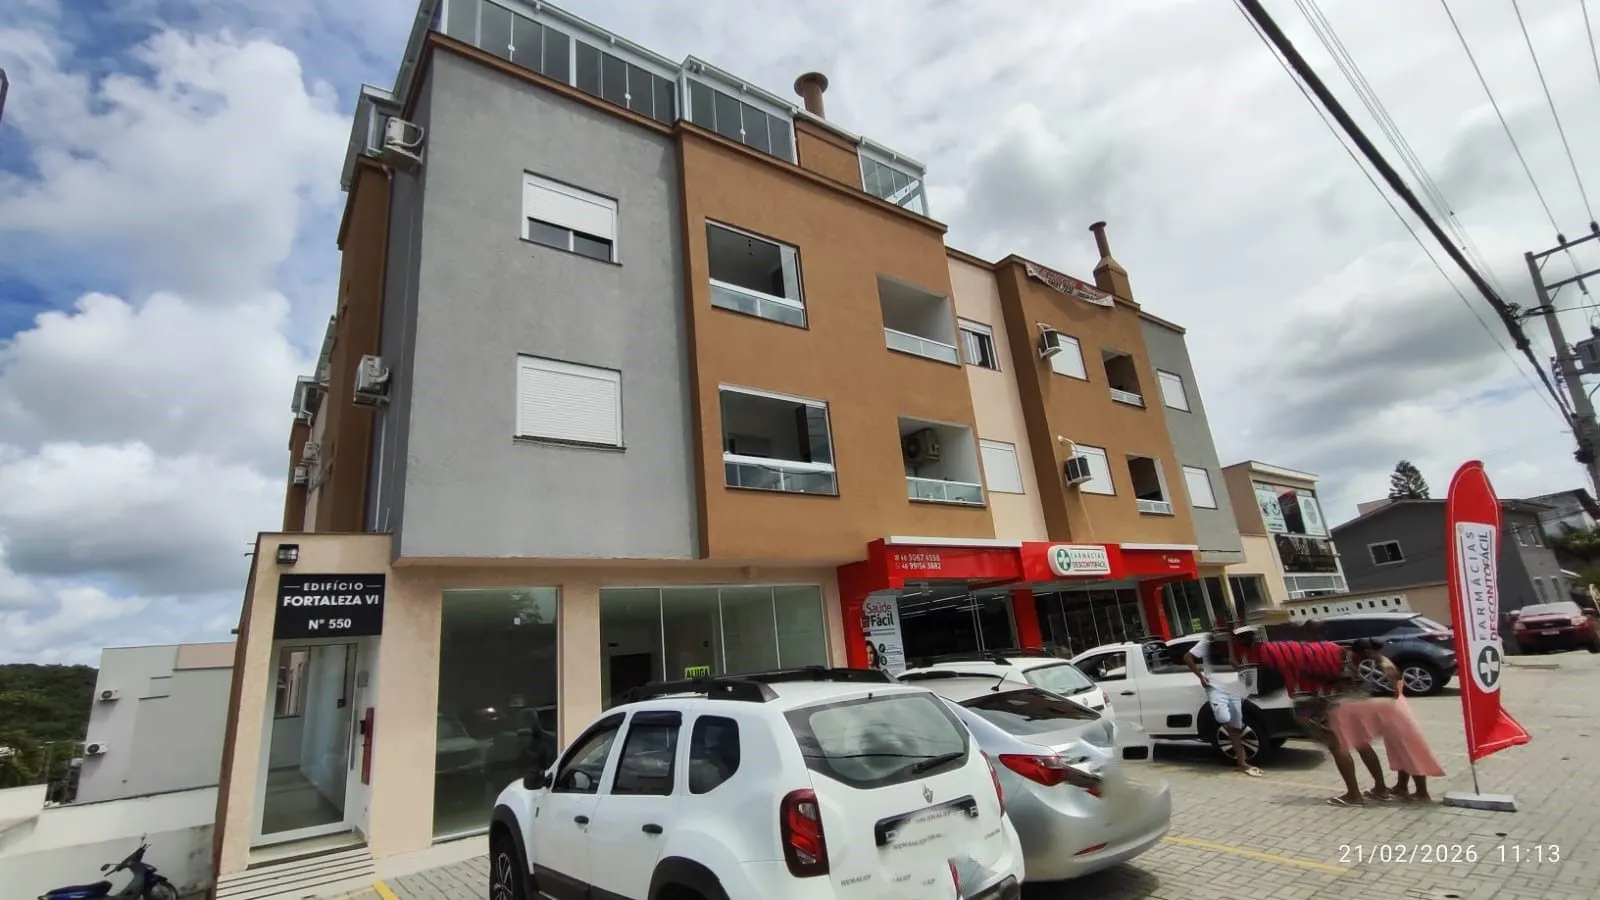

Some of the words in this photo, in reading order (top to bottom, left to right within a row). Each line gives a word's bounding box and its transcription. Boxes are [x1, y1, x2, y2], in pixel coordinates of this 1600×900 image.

[303, 580, 364, 591] EDIFÍCIO
[1466, 531, 1487, 641] FARMÁCIAS
[283, 595, 362, 607] FORTALEZA
[365, 594, 379, 605] VI
[866, 602, 892, 614] Saúde
[328, 618, 352, 629] 550
[870, 612, 895, 627] Fácil
